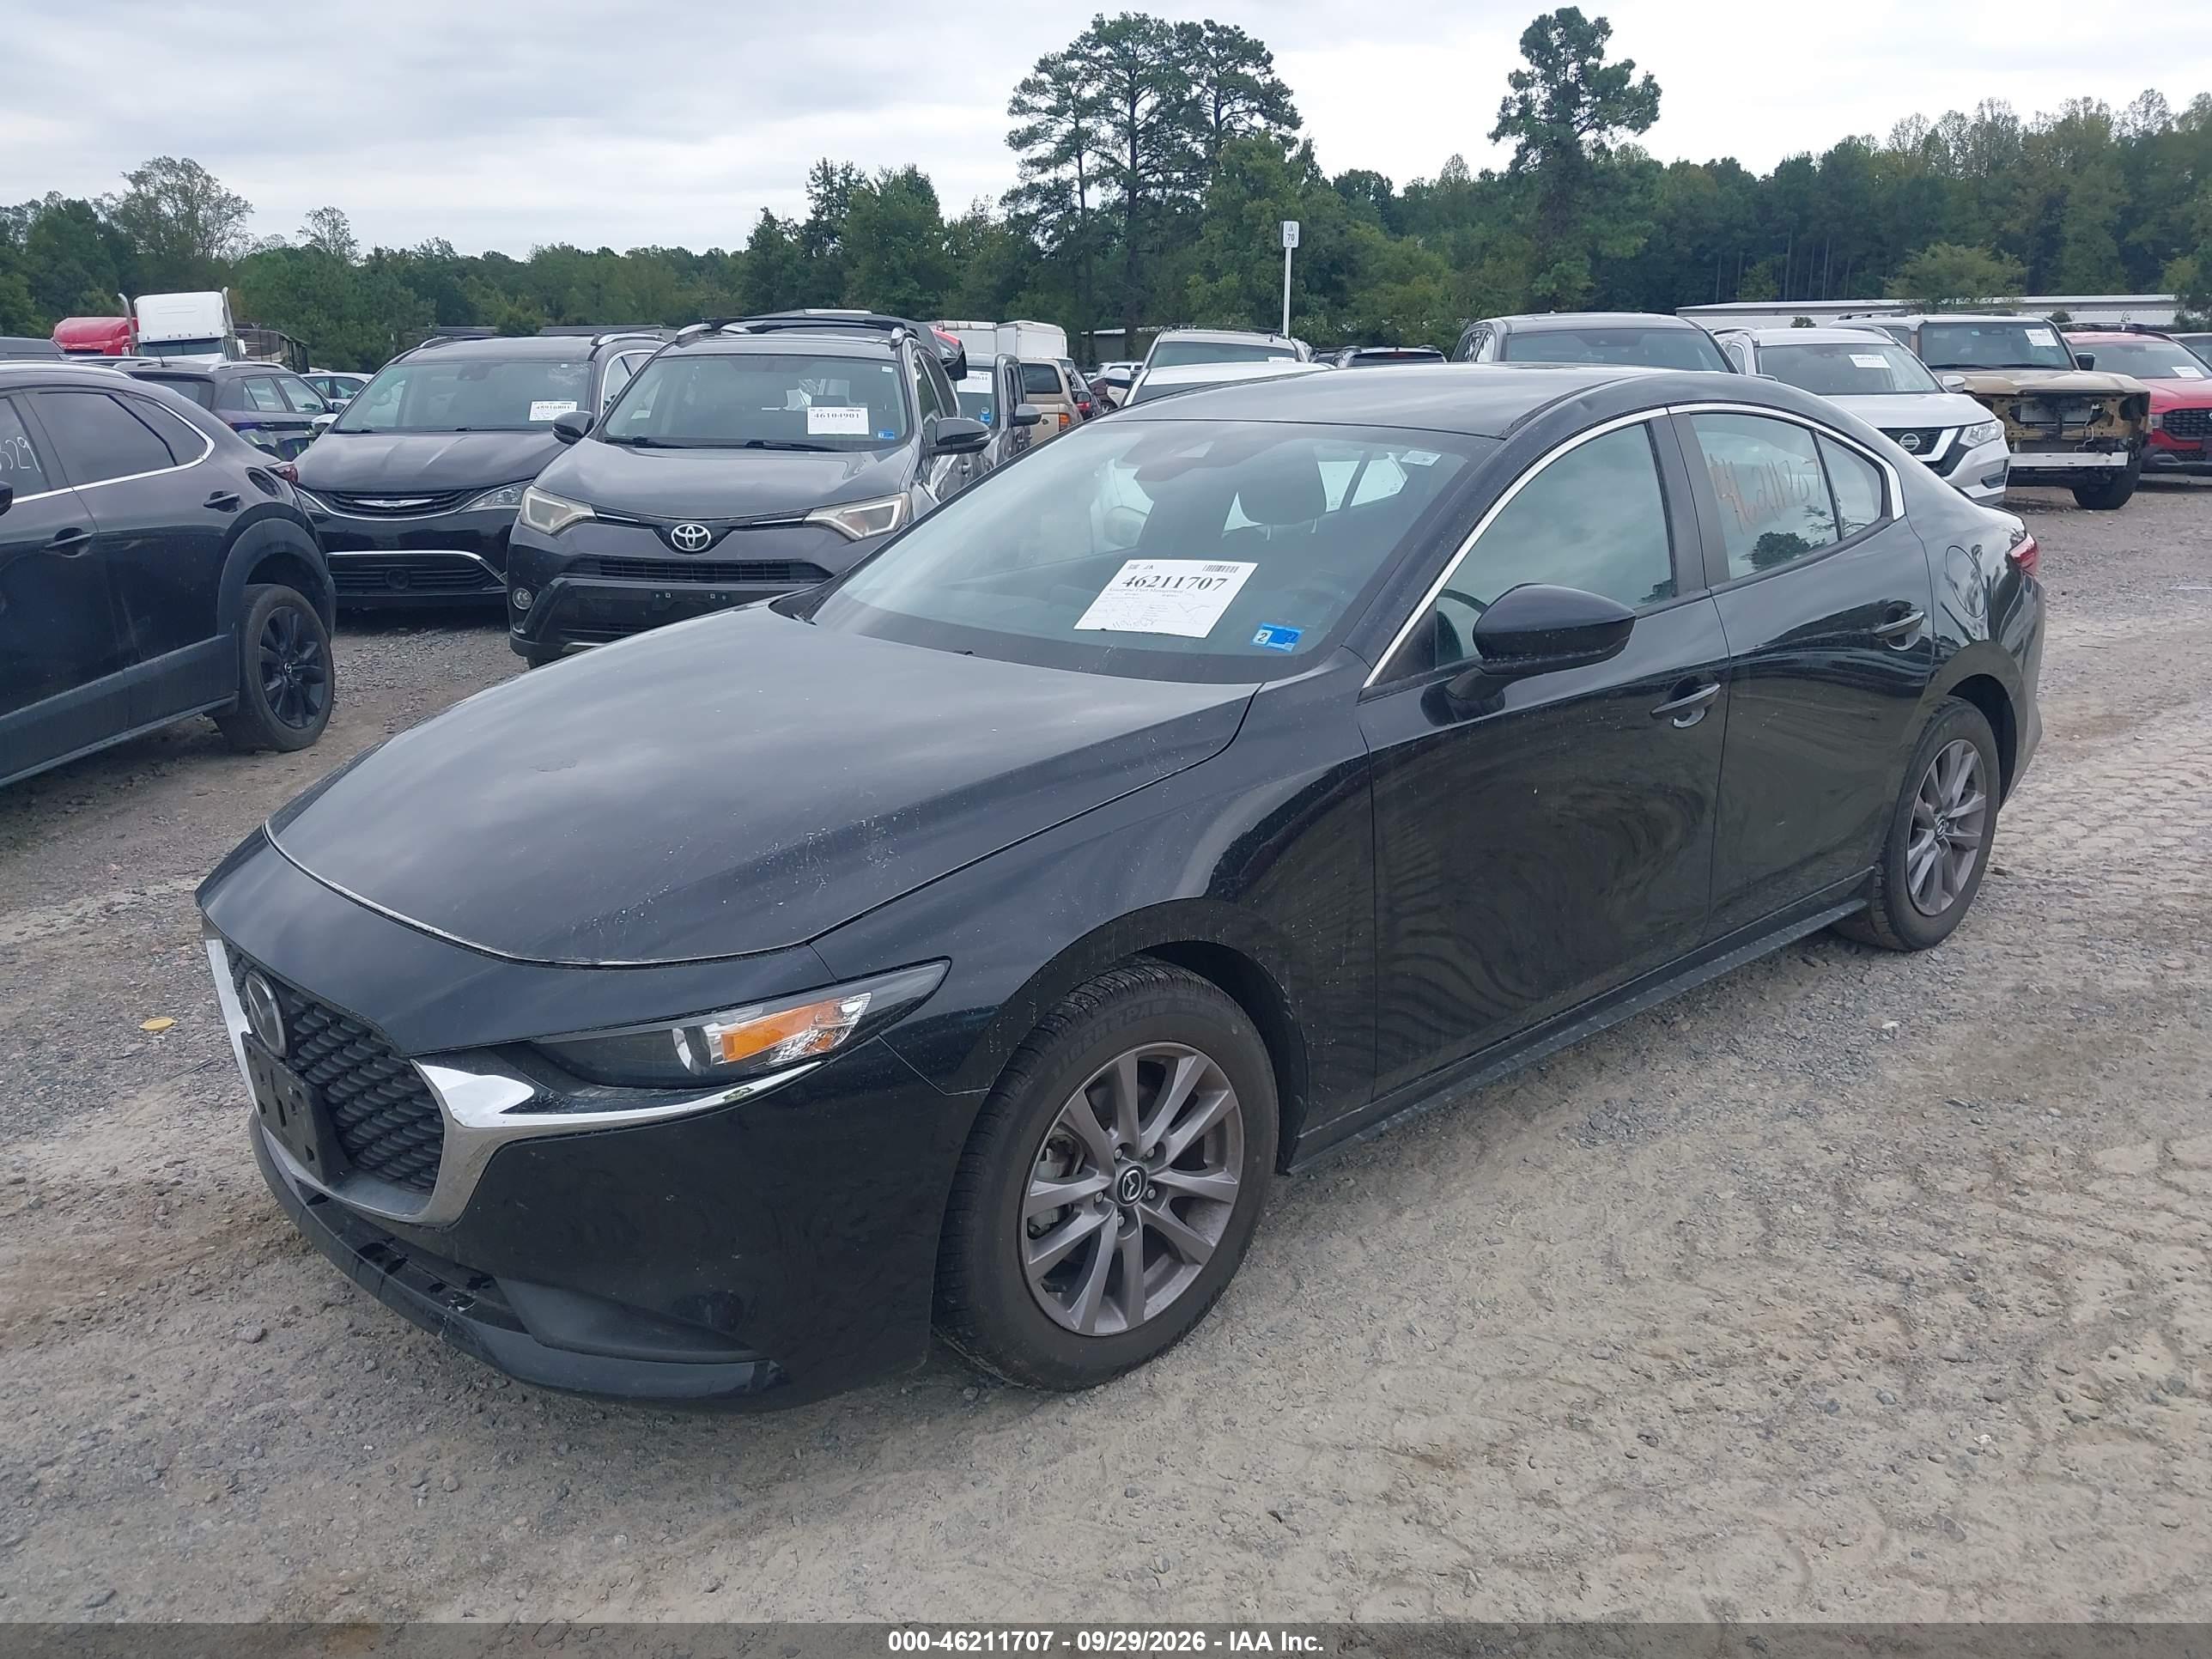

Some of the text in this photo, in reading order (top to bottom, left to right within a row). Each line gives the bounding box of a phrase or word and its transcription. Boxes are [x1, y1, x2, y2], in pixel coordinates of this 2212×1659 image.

[1287, 233, 1295, 241] 70
[1121, 574, 1229, 592] 46211707
[1257, 632, 1268, 642] 2
